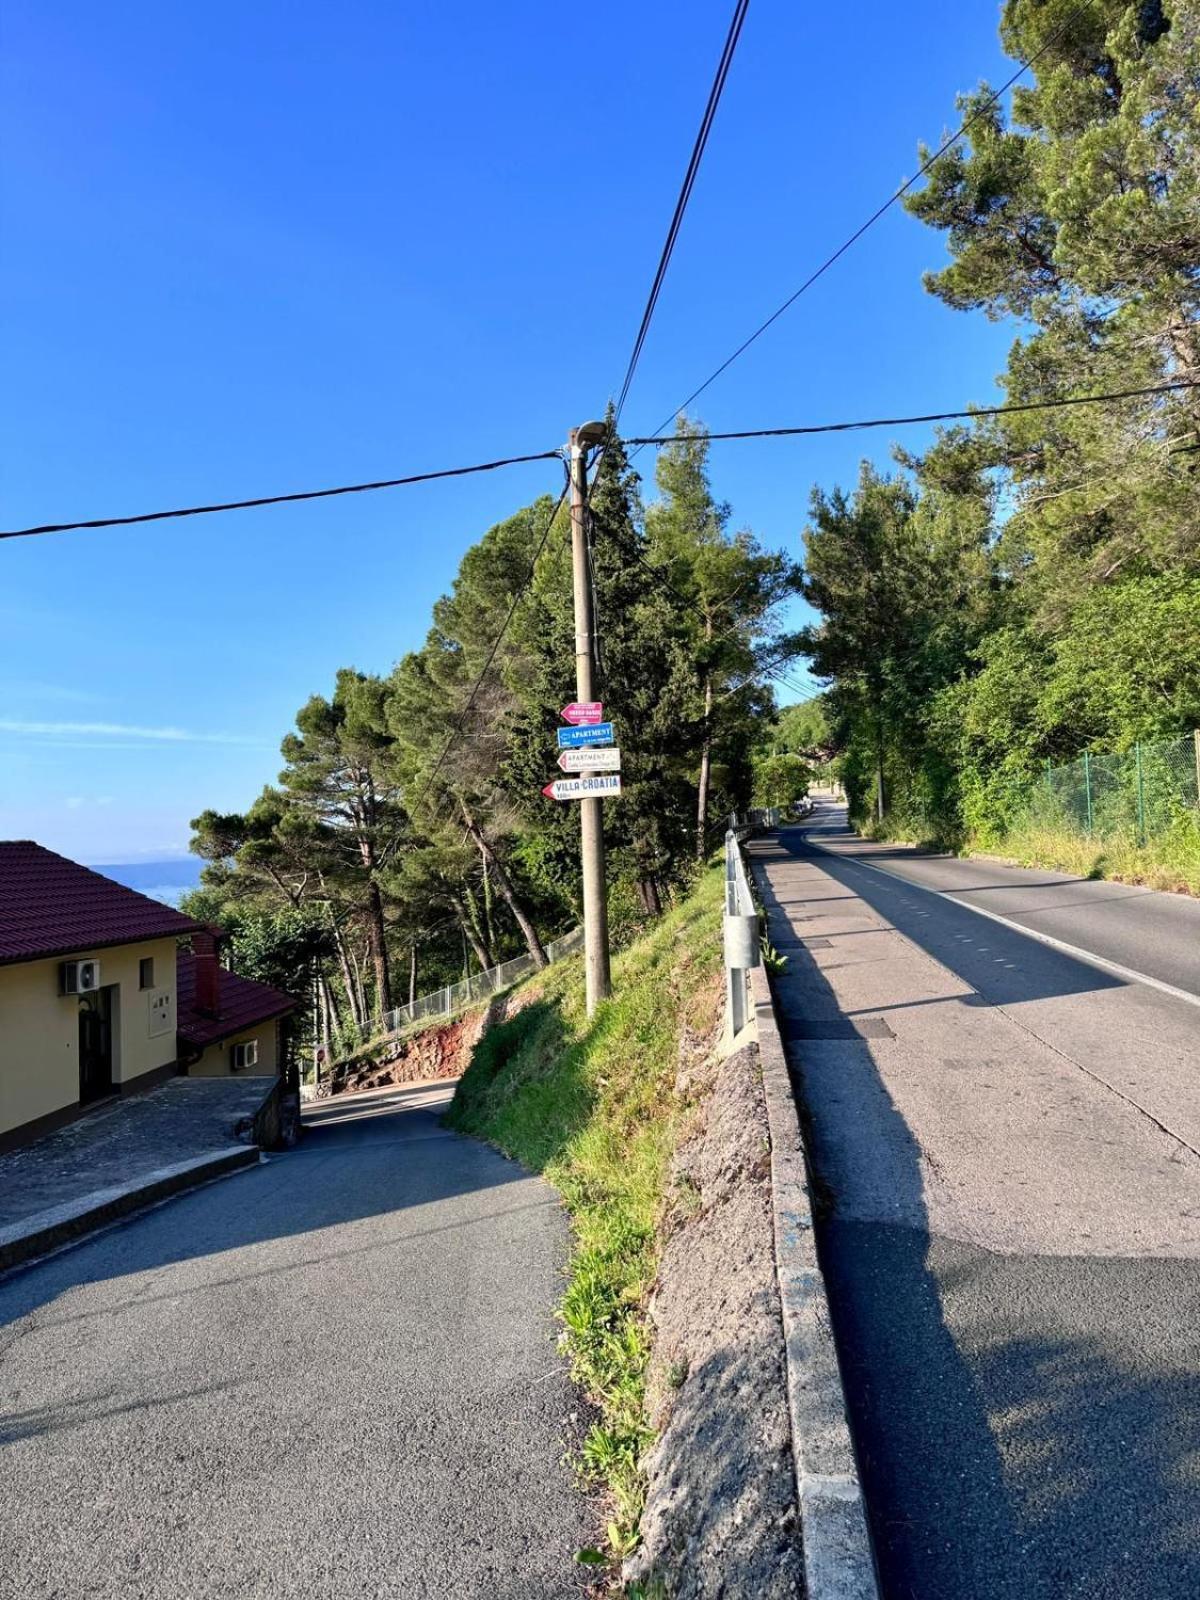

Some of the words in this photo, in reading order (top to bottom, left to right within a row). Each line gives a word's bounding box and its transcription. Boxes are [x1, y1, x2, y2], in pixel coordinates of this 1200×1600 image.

[571, 728, 610, 739] APARTMENT
[568, 753, 605, 761] APARTMENT
[556, 781, 580, 792] VILLA
[582, 777, 618, 790] CROATIA
